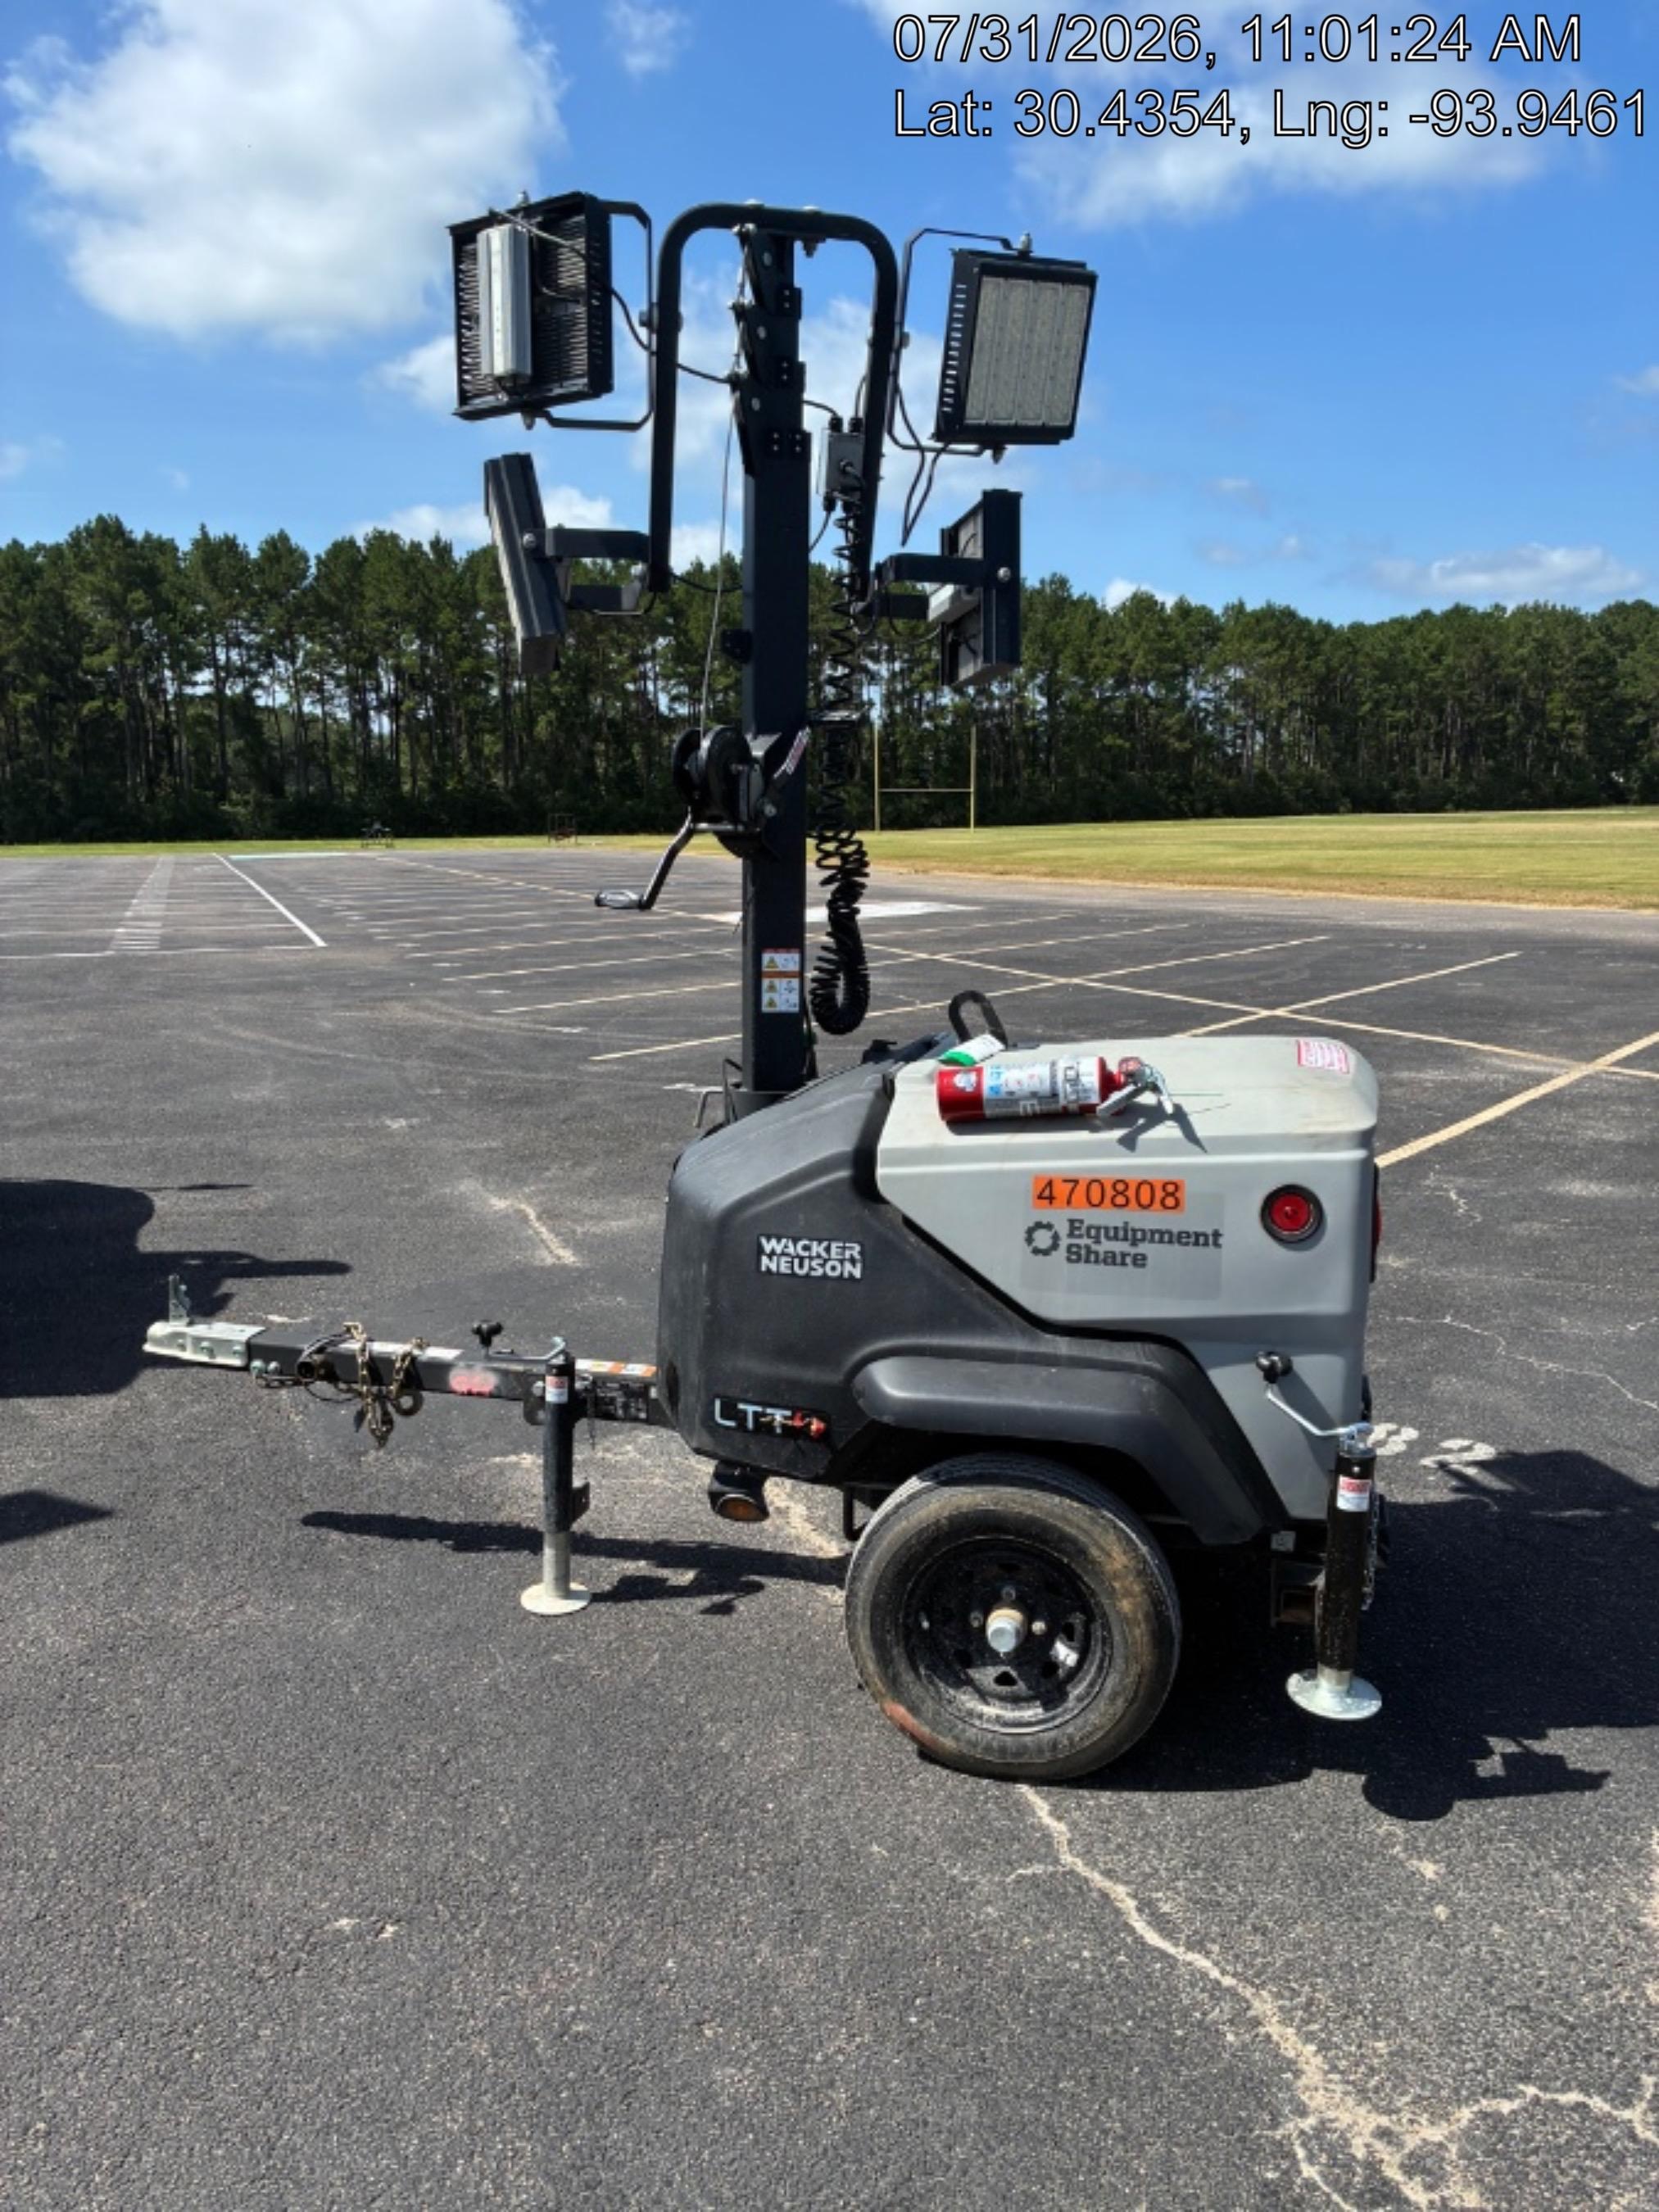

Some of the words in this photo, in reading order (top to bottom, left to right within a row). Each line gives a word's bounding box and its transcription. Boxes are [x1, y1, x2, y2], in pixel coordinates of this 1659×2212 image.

[1036, 1178, 1182, 1210] 470808
[1066, 1218, 1223, 1249] Equipment
[759, 1235, 861, 1259] WACKER
[1065, 1243, 1148, 1268] Share
[760, 1255, 862, 1279] NEUSON
